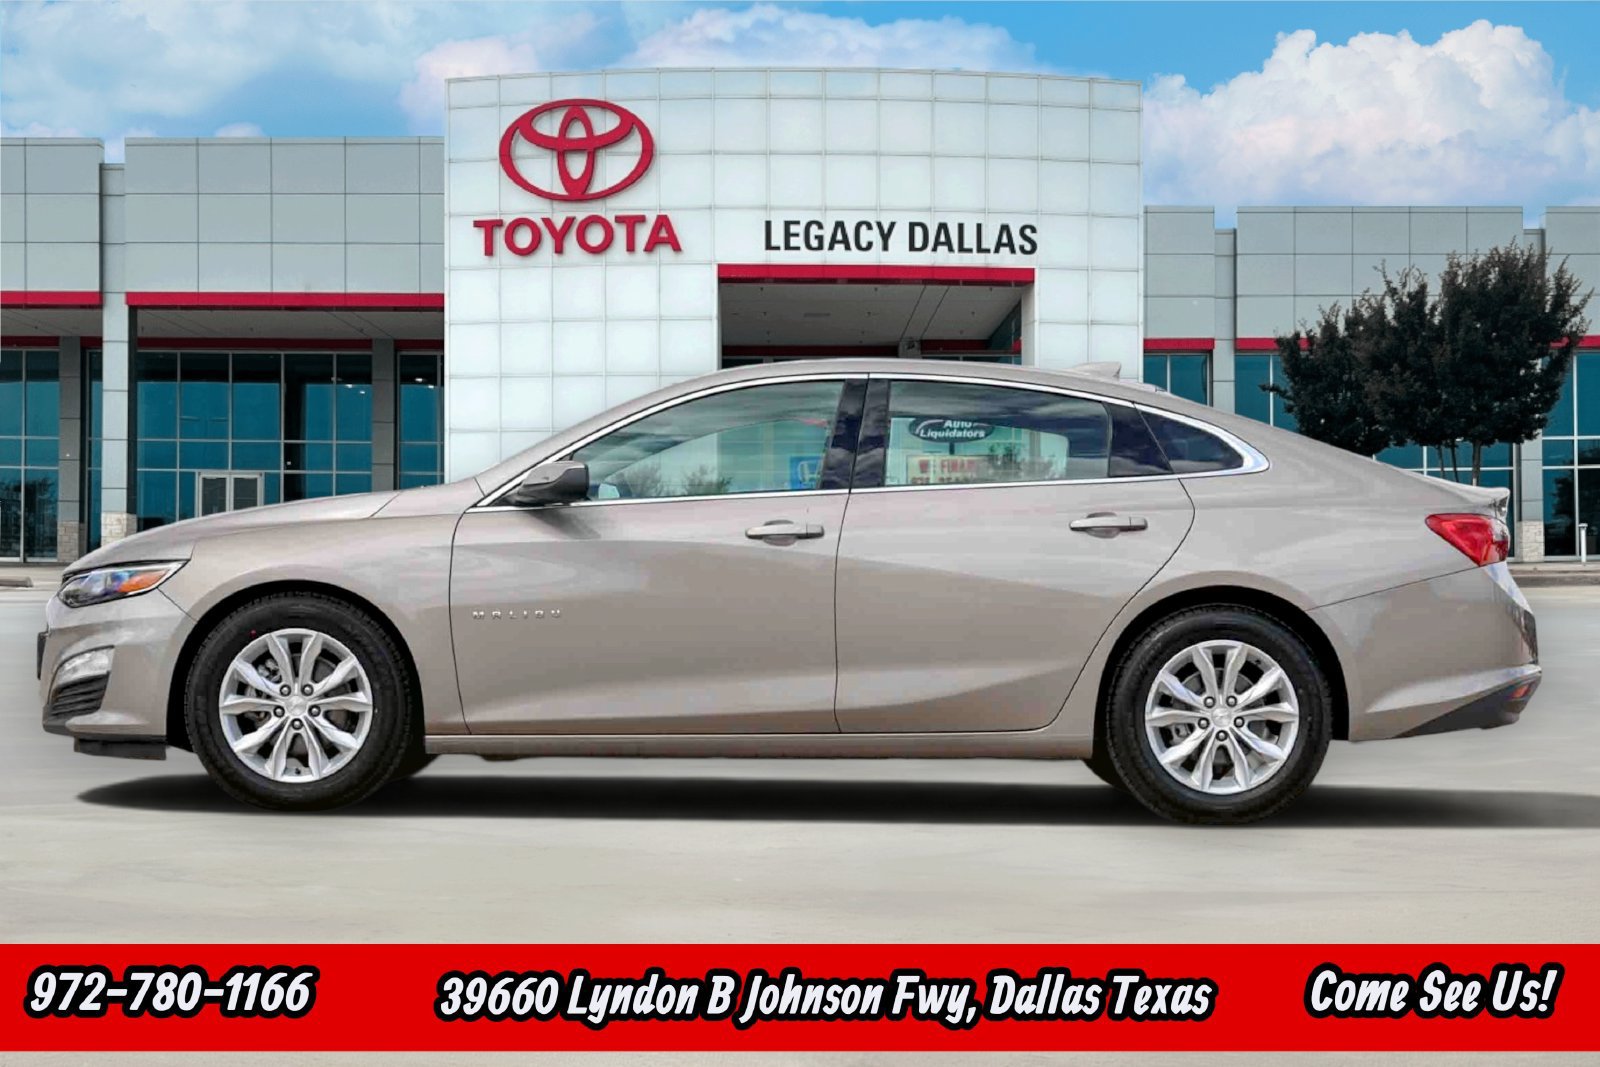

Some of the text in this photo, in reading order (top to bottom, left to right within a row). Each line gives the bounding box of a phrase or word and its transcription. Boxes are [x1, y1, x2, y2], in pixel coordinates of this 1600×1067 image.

[473, 213, 683, 257] TOYOTA
[764, 219, 1039, 256] LEGACY DALLAS
[920, 428, 986, 439] Liquidators
[472, 609, 562, 620] MALIBU
